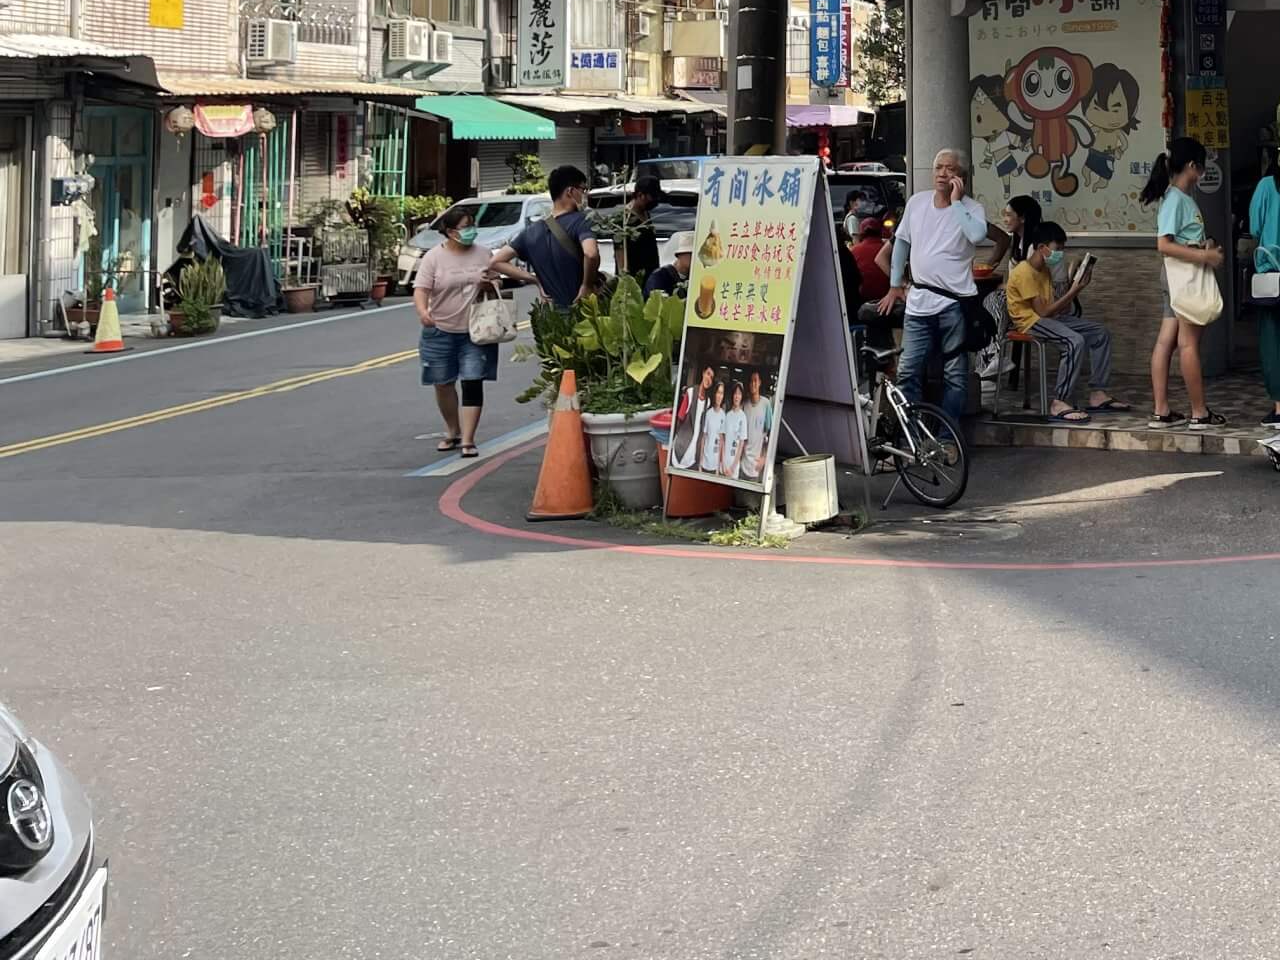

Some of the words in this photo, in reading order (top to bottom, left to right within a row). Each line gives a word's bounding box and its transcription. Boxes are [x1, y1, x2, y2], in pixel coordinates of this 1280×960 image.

[730, 220, 797, 242] 三立草地狀元
[726, 243, 796, 264] TVBS食尚玩家
